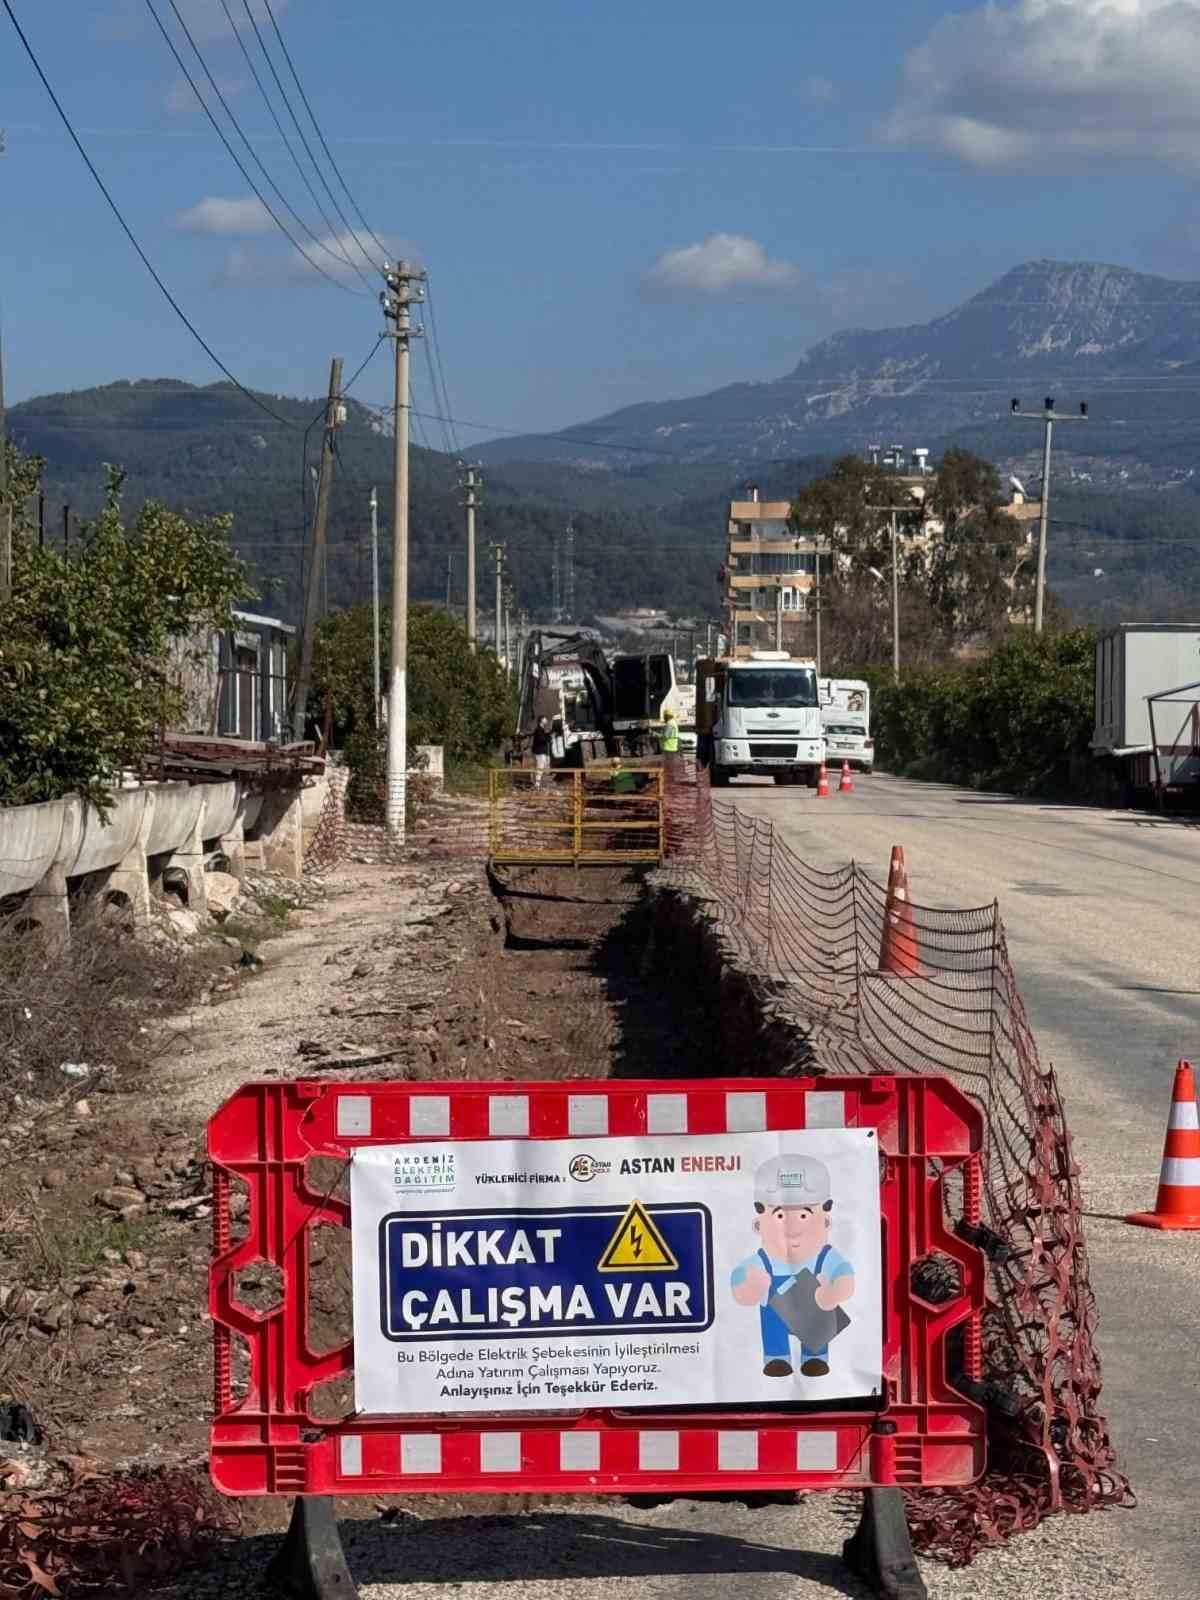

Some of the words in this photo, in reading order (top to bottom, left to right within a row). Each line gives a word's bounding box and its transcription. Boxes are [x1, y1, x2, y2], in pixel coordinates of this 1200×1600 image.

[619, 1157, 675, 1175] ASTAN
[475, 1172, 527, 1184] YÜKLENİCİ
[402, 1222, 562, 1268] DİKKAT
[402, 1284, 595, 1330] ÇALIŞMA
[604, 1281, 692, 1318] VAR
[397, 1351, 414, 1362] Bu
[419, 1349, 473, 1364] Bölgede
[478, 1347, 528, 1360] Elektrik
[532, 1344, 610, 1362] Şebekesinin
[615, 1341, 700, 1359] İyileştirilmesi
[436, 1366, 474, 1379] Adına
[478, 1366, 524, 1378] Yatırım
[528, 1363, 589, 1380] Çalışması
[593, 1362, 662, 1378] Yapıyoruz.
[440, 1384, 513, 1399] Anlayışınız
[517, 1380, 541, 1397] İçin
[544, 1380, 606, 1396] Teşekkür
[610, 1378, 659, 1392] Ederiz.
